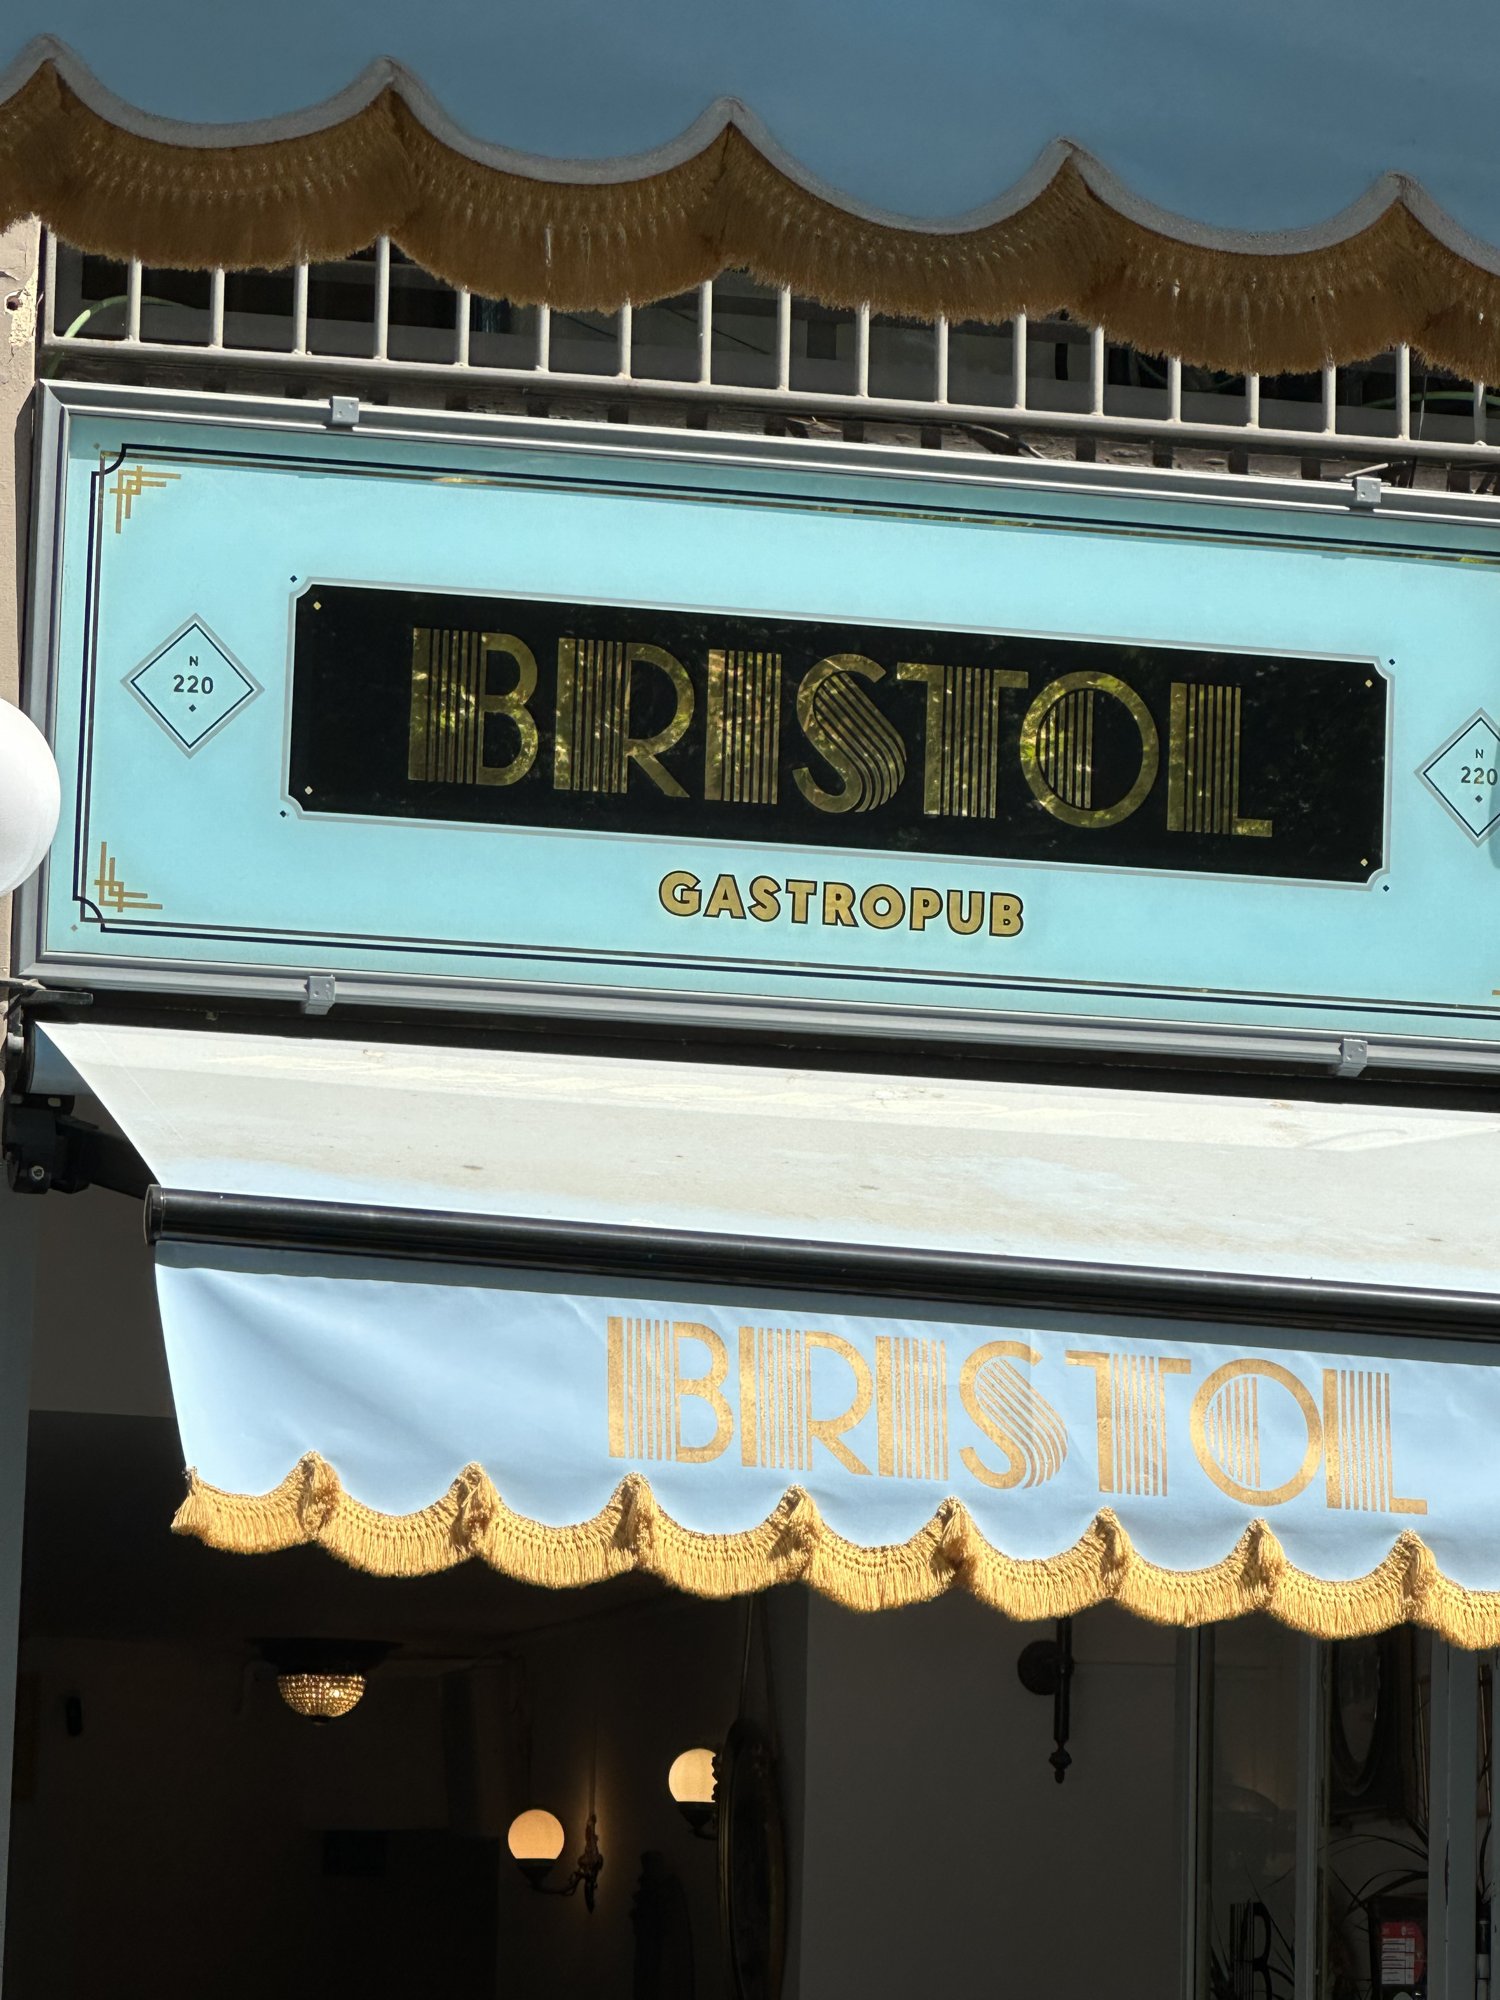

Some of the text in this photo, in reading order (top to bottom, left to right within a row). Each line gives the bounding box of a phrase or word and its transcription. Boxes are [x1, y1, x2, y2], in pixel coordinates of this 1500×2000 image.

[189, 656, 198, 666] N
[173, 674, 214, 694] 220
[408, 628, 1274, 838] BRISTOL
[1475, 749, 1484, 759] N
[1460, 766, 1498, 785] 220
[658, 870, 1024, 938] GASTROPUB
[606, 1316, 1428, 1515] BRISTOL
